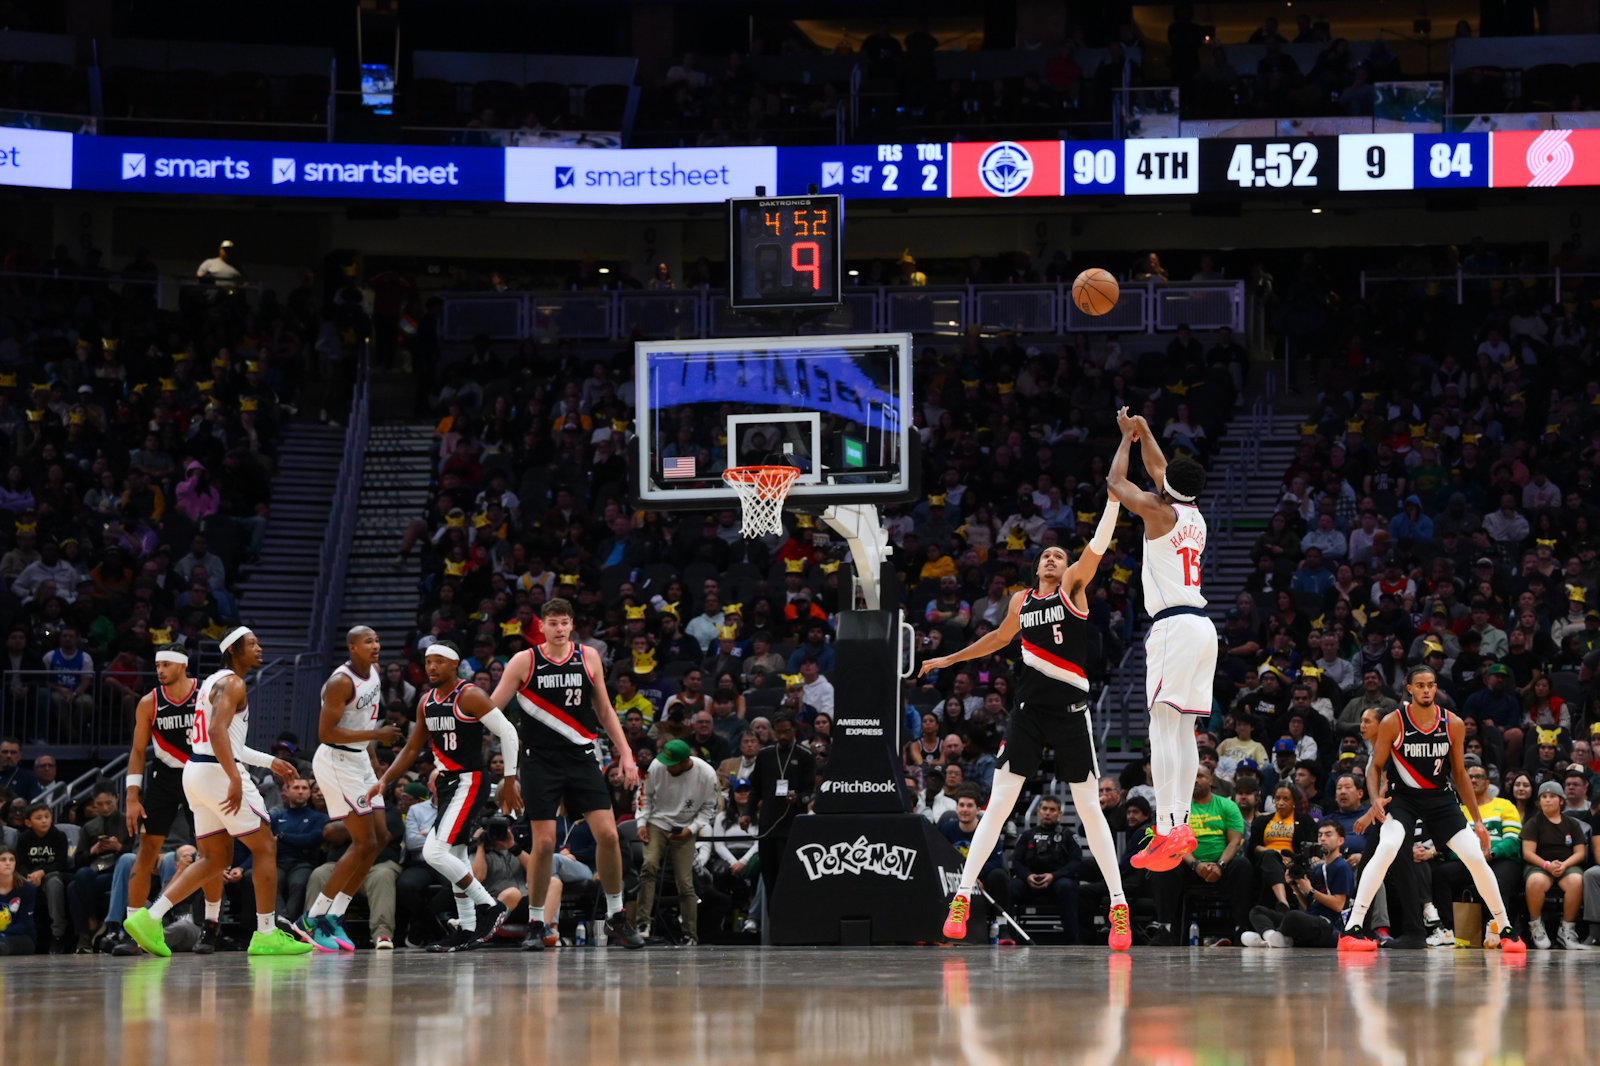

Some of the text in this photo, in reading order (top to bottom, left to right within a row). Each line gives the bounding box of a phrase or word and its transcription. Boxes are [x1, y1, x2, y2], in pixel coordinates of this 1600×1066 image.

[877, 144, 903, 162] FLS
[916, 143, 943, 161] TOL
[1226, 142, 1319, 187] 4:52
[1366, 145, 1386, 179] 9
[1429, 142, 1473, 179] 84
[154, 155, 250, 180] smarts
[303, 155, 459, 185] smartsheet
[584, 161, 730, 187] smartsheet
[881, 164, 899, 191] 2
[921, 164, 939, 191] 2
[1073, 149, 1116, 185] 90
[1136, 152, 1188, 180] 4TH
[759, 199, 811, 207] DAKTRONICS
[793, 209, 828, 237] 52
[790, 241, 820, 291] 9
[1176, 547, 1201, 587] 15
[1019, 604, 1065, 629] PORTLAND
[1052, 623, 1064, 645] 5
[537, 673, 583, 689] PORTLAND
[564, 688, 583, 707] 23
[156, 713, 195, 730] PORTLAN
[192, 709, 208, 744] 31
[836, 718, 880, 727] AMERICAN
[845, 727, 884, 737] EXPRESS
[442, 731, 458, 751] 18
[1403, 742, 1450, 758] PORTLAND
[831, 779, 896, 793] PitchBook
